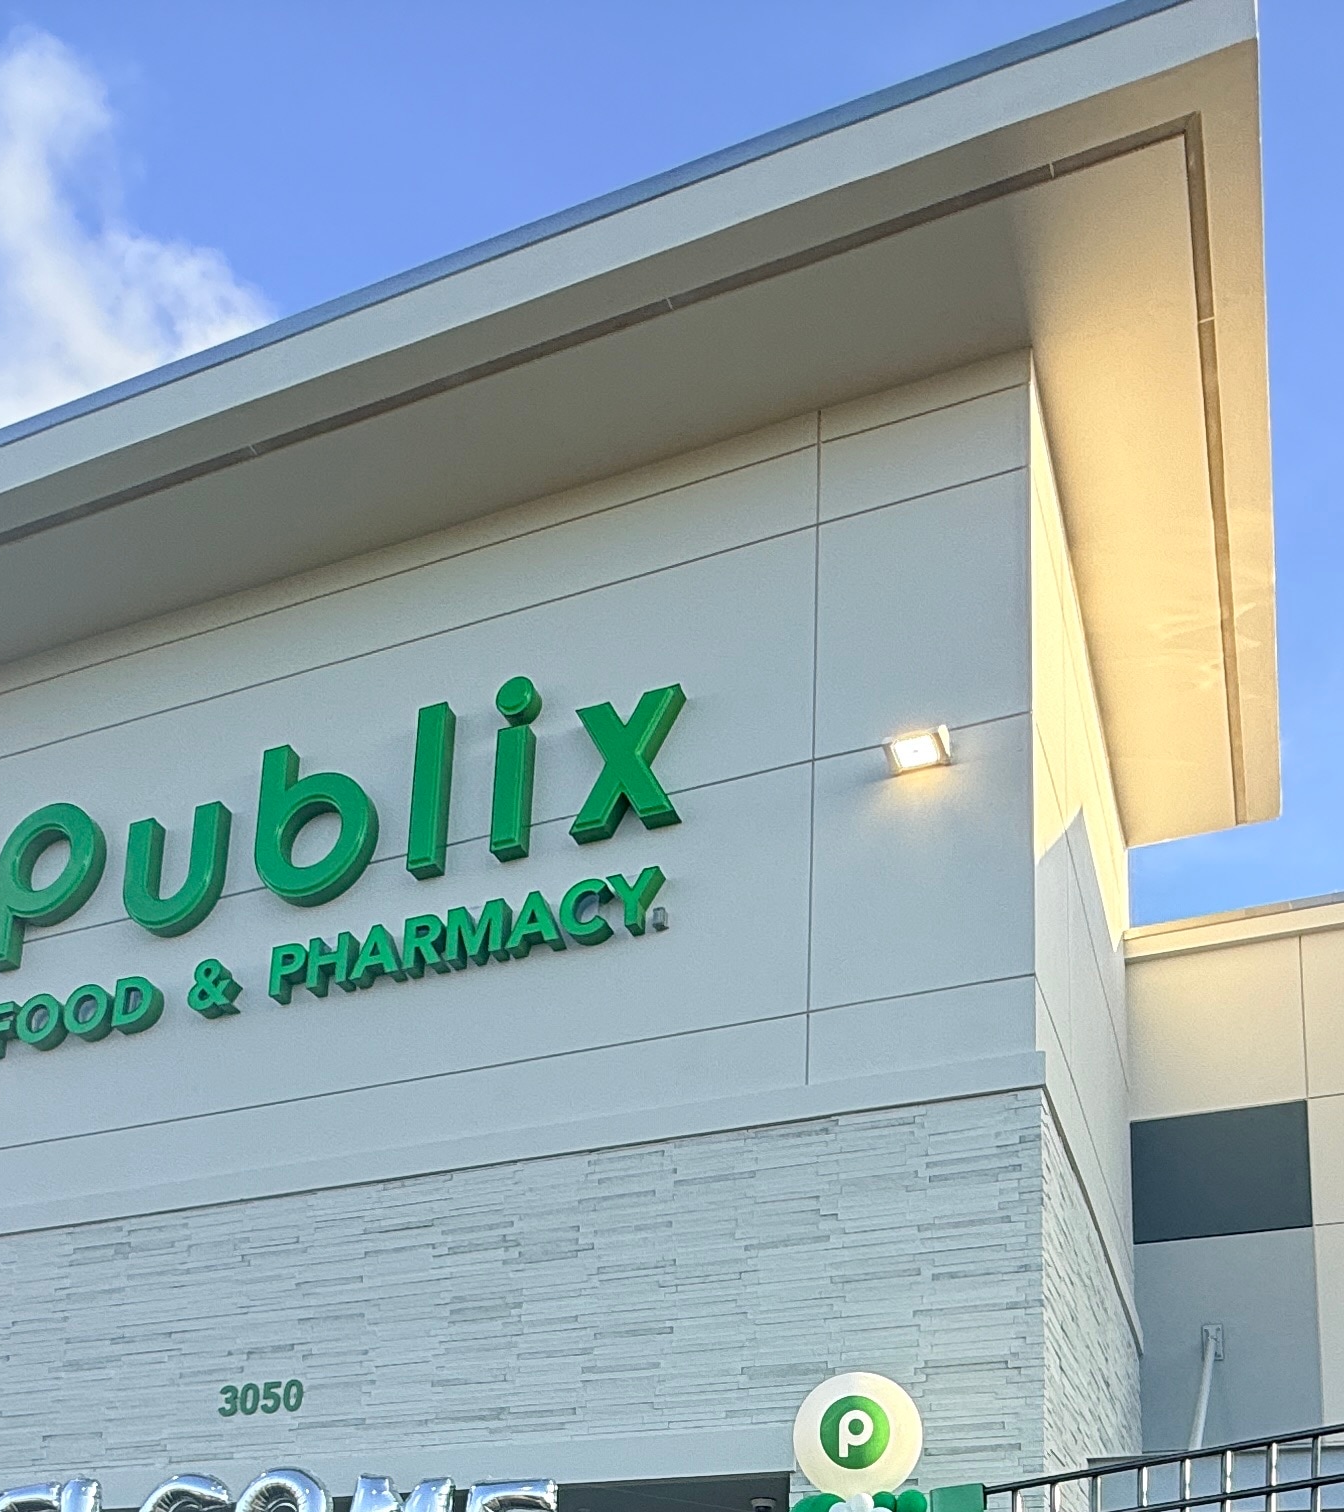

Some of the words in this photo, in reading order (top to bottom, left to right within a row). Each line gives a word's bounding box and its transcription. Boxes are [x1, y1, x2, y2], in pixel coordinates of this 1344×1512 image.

[188, 959, 242, 1019] &
[269, 866, 666, 1004] PHARMACY
[218, 1379, 304, 1417] 3050
